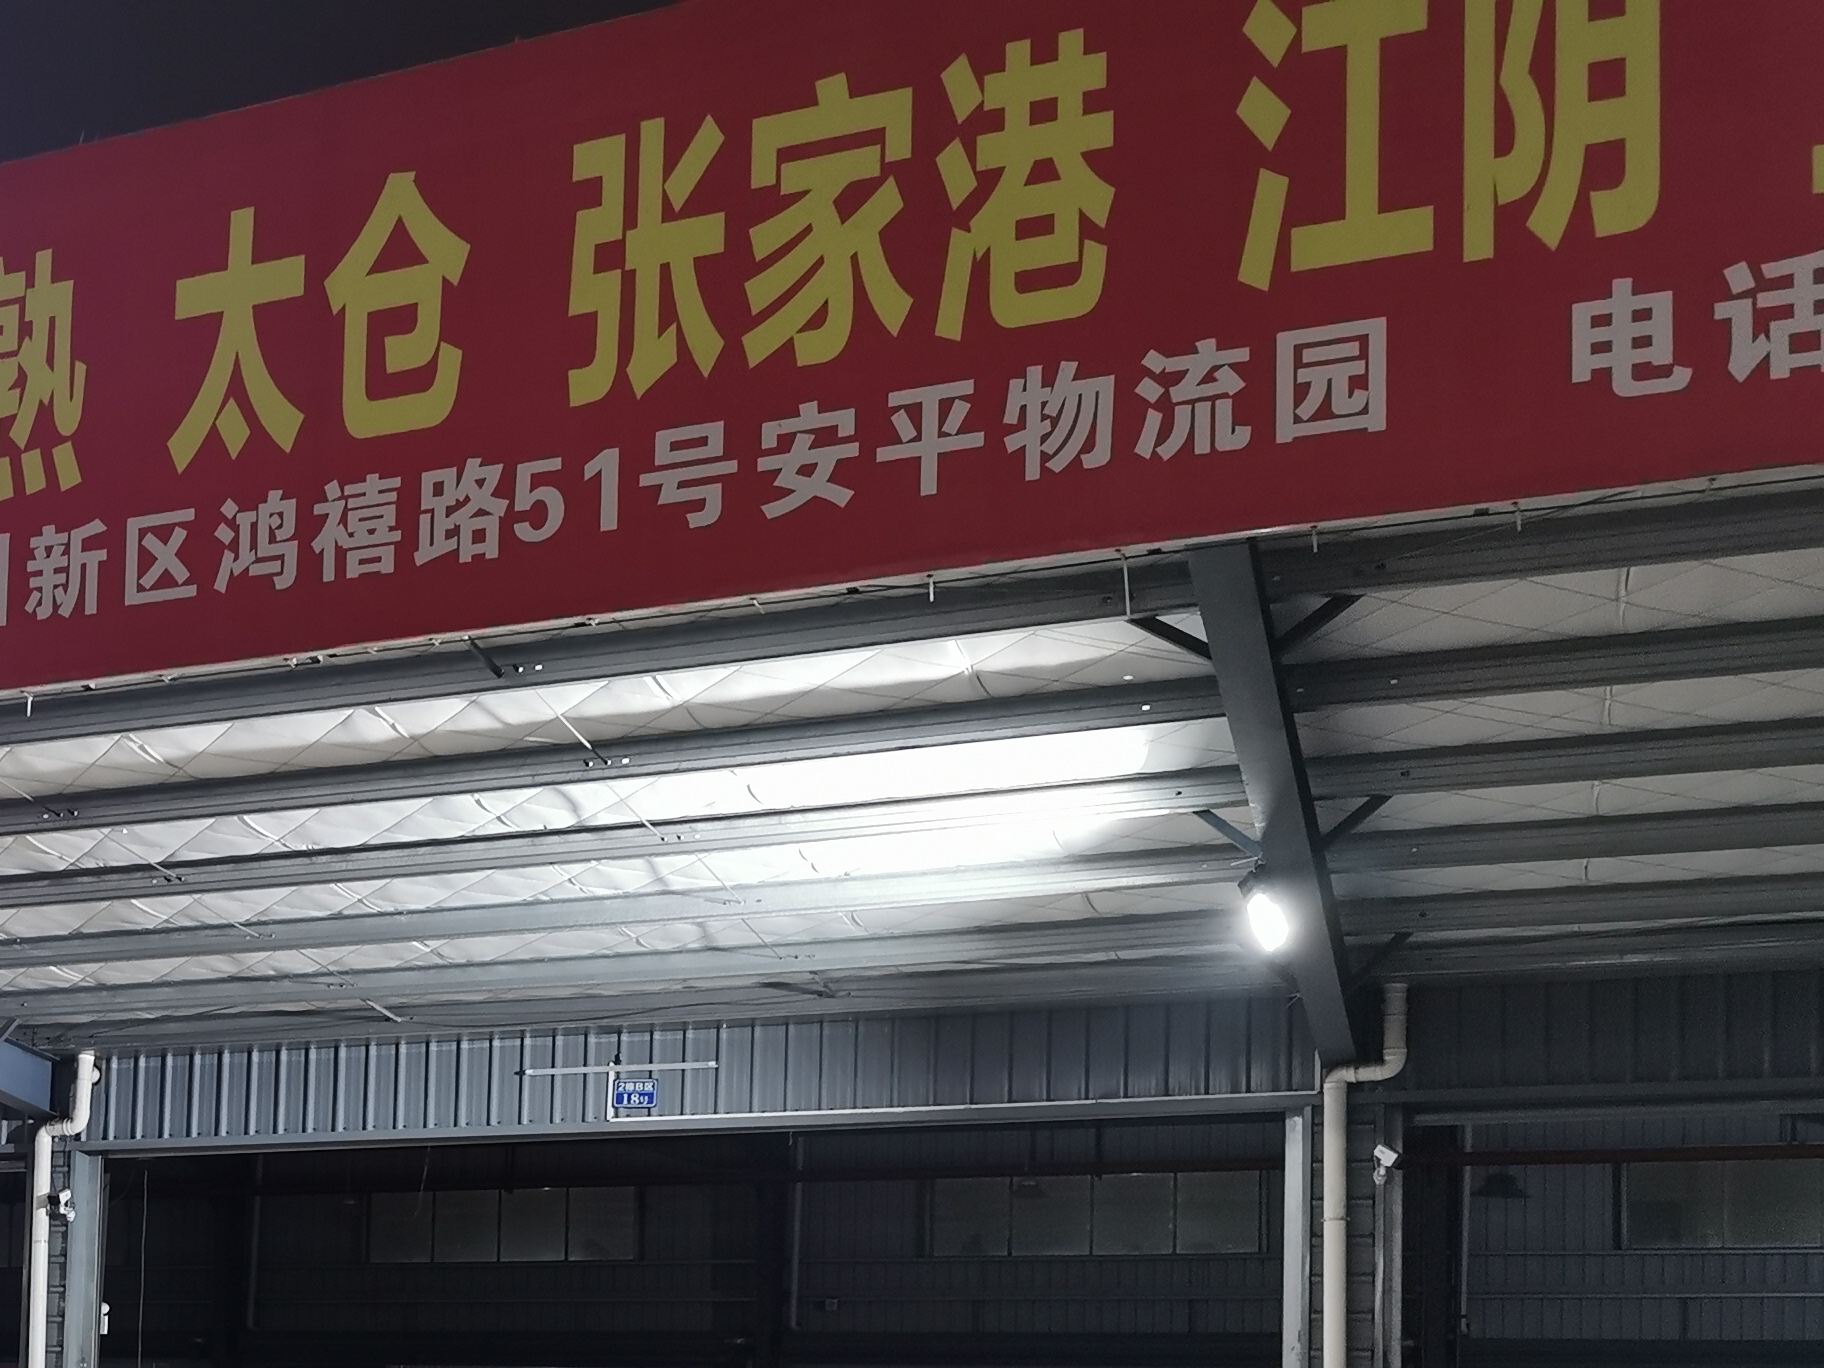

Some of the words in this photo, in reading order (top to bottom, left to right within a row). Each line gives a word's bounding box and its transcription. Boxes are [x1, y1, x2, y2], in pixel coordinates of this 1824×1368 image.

[166, 172, 471, 473] 太仓
[567, 29, 1115, 407] 张家港
[1236, 0, 1661, 289] 江阴
[1571, 249, 1824, 397] 电话
